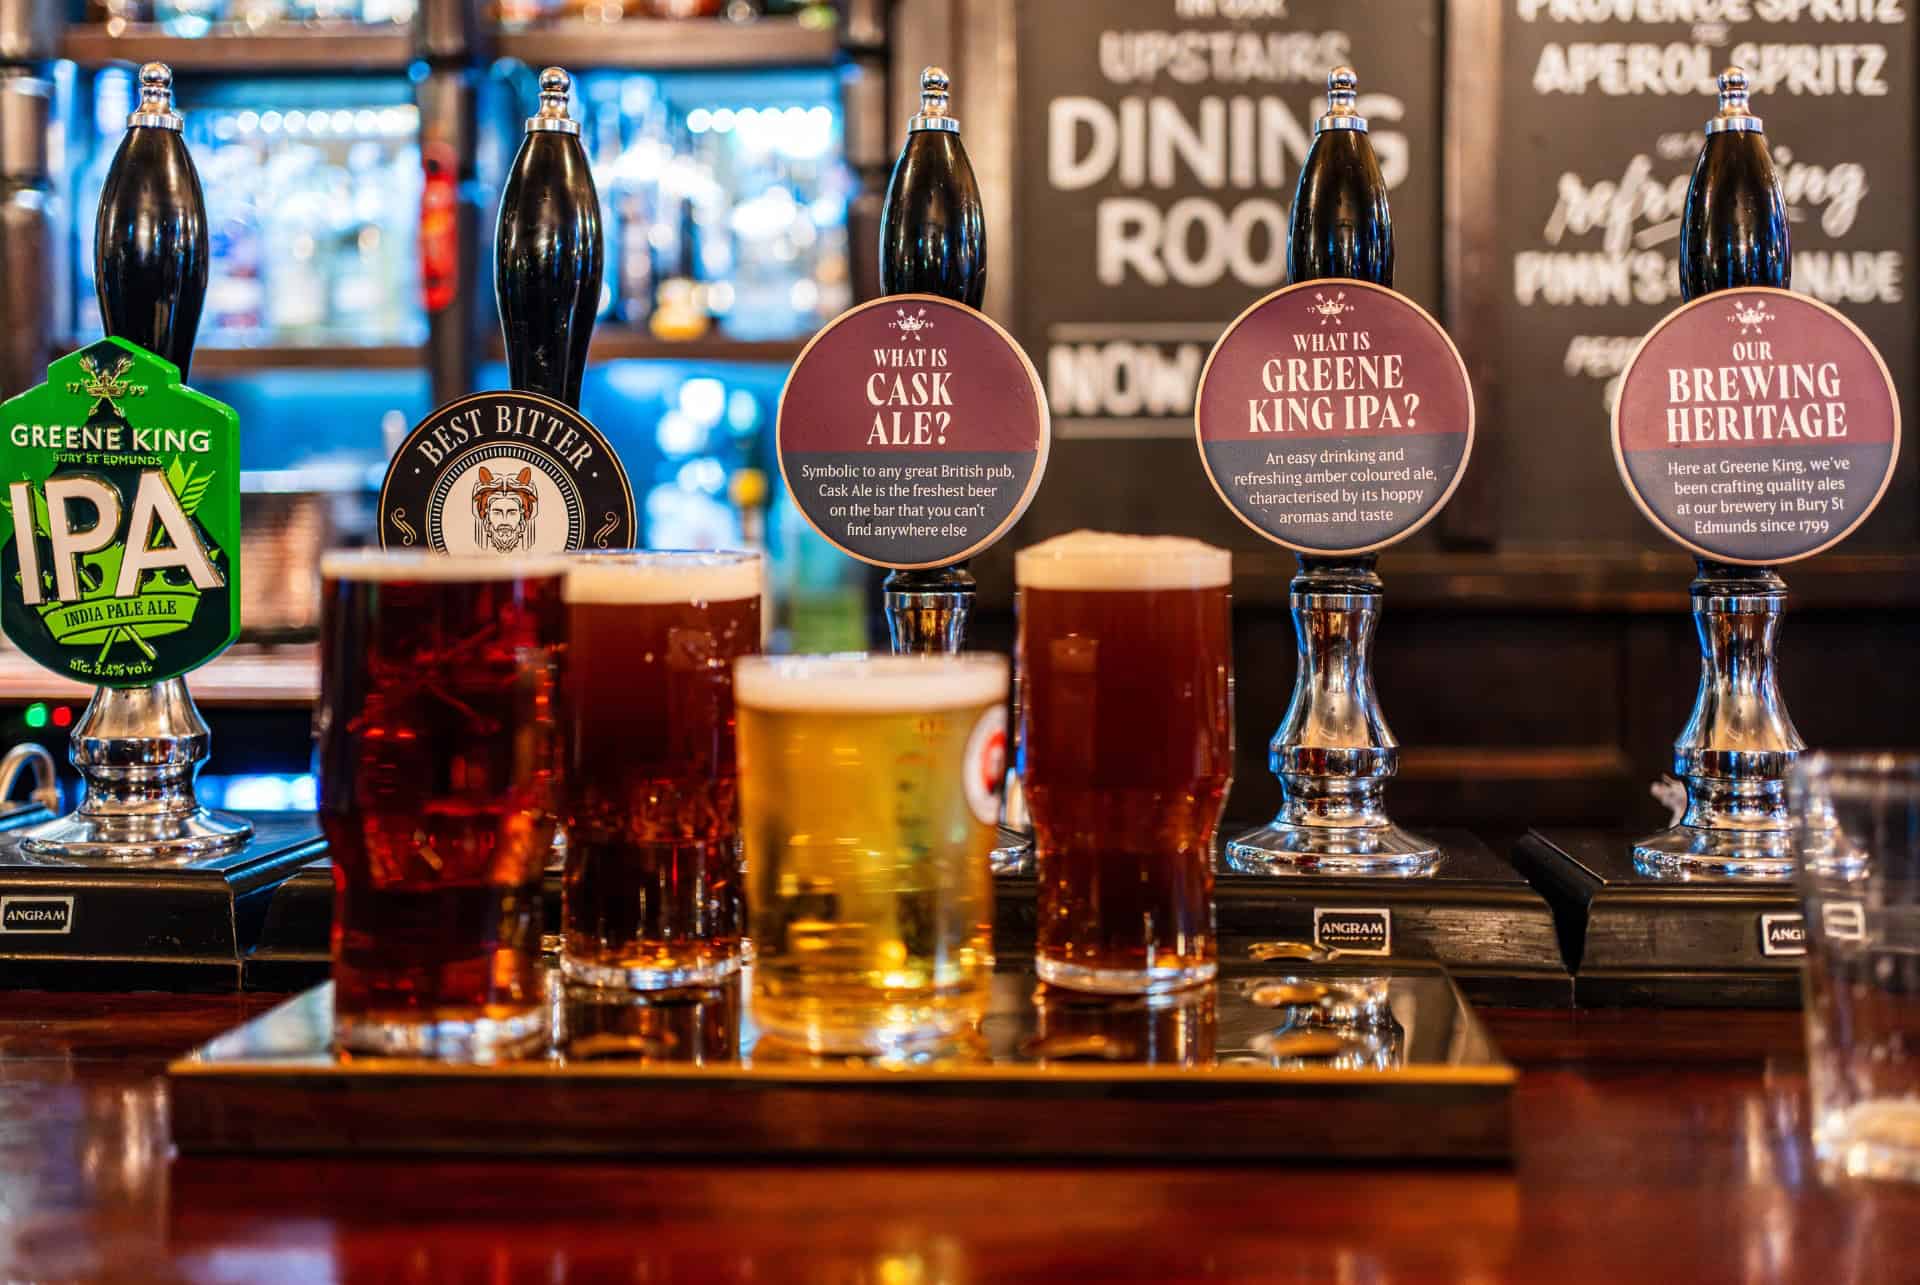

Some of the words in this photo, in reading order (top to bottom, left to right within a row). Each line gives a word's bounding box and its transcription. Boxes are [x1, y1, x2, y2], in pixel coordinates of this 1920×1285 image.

[1100, 31, 1351, 82] UPSTAIRS
[1534, 43, 1716, 95] APEROL
[1730, 43, 1888, 96] SPRITZ
[1097, 198, 1284, 287] ROO
[1293, 333, 1348, 352] WHAT
[1353, 332, 1371, 350] IS
[1733, 341, 1773, 361] OUR
[873, 349, 927, 367] WHAT
[931, 349, 947, 367] IS
[1262, 355, 1404, 393] GREENE
[1668, 363, 1841, 404] BREWING
[866, 372, 952, 406] CASK
[1248, 396, 1335, 433] KING
[1344, 393, 1420, 430] IPA?
[1666, 402, 1848, 443] HERITAGE
[10, 424, 122, 450] GREENE
[132, 427, 211, 453] KING
[417, 408, 482, 467] BEST
[495, 405, 593, 471] BITTER
[866, 411, 952, 446] ALE?
[53, 452, 82, 463] BURY
[86, 453, 100, 464] ST
[103, 454, 163, 466] EDMUNDS
[1266, 453, 1284, 465] An
[1287, 454, 1317, 467] easy
[1320, 450, 1376, 464] drinking
[1379, 449, 1404, 461] and
[1668, 462, 1700, 475] Here
[1703, 462, 1717, 474] at
[1720, 460, 1769, 474] Greene
[1772, 458, 1807, 473] King,
[1810, 456, 1850, 471] we've
[802, 465, 858, 479] Symbolic
[863, 466, 875, 477] to
[879, 468, 900, 480] any
[905, 466, 937, 480] great
[941, 465, 983, 478] British
[987, 465, 1015, 480] pub,
[1234, 472, 1302, 487] refreshing
[1305, 468, 1347, 483] amber
[1350, 468, 1410, 482] coloured
[1413, 467, 1437, 481] ale,
[819, 485, 849, 497] Cask
[852, 485, 872, 497] Ale
[876, 485, 885, 497] is
[889, 485, 910, 497] the
[913, 484, 964, 497] freshest
[968, 485, 997, 497] beer
[1249, 489, 1339, 505] characterised
[1342, 489, 1358, 504] by
[1362, 489, 1378, 501] its
[1381, 487, 1424, 504] hoppy
[1674, 482, 1708, 495] been
[1711, 480, 1764, 495] crafting
[1767, 477, 1814, 493] quality
[1817, 477, 1845, 490] ales
[830, 507, 846, 517] on
[850, 505, 871, 517] the
[873, 504, 895, 517] bar
[899, 505, 924, 517] that
[927, 507, 951, 520] you
[954, 504, 985, 517] can't
[1677, 502, 1691, 514] at
[1694, 503, 1717, 514] our
[1720, 498, 1777, 514] brewery
[1780, 499, 1793, 512] in
[1796, 498, 1828, 513] Bury
[1831, 497, 1844, 510] St
[1279, 511, 1329, 524] aromas
[1332, 508, 1357, 522] and
[1360, 508, 1393, 521] taste
[1695, 519, 1757, 534] Edmunds
[1760, 518, 1796, 532] since
[1799, 520, 1830, 534] 1799
[9, 468, 225, 605] IPA
[847, 524, 872, 536] find
[874, 524, 938, 539] anywhere
[941, 524, 967, 536] else
[64, 609, 103, 627] INDIA
[106, 603, 144, 619] PALE
[147, 600, 177, 616] ALE
[6, 910, 65, 921] ANGRAM
[1321, 922, 1384, 934] ANGRAM
